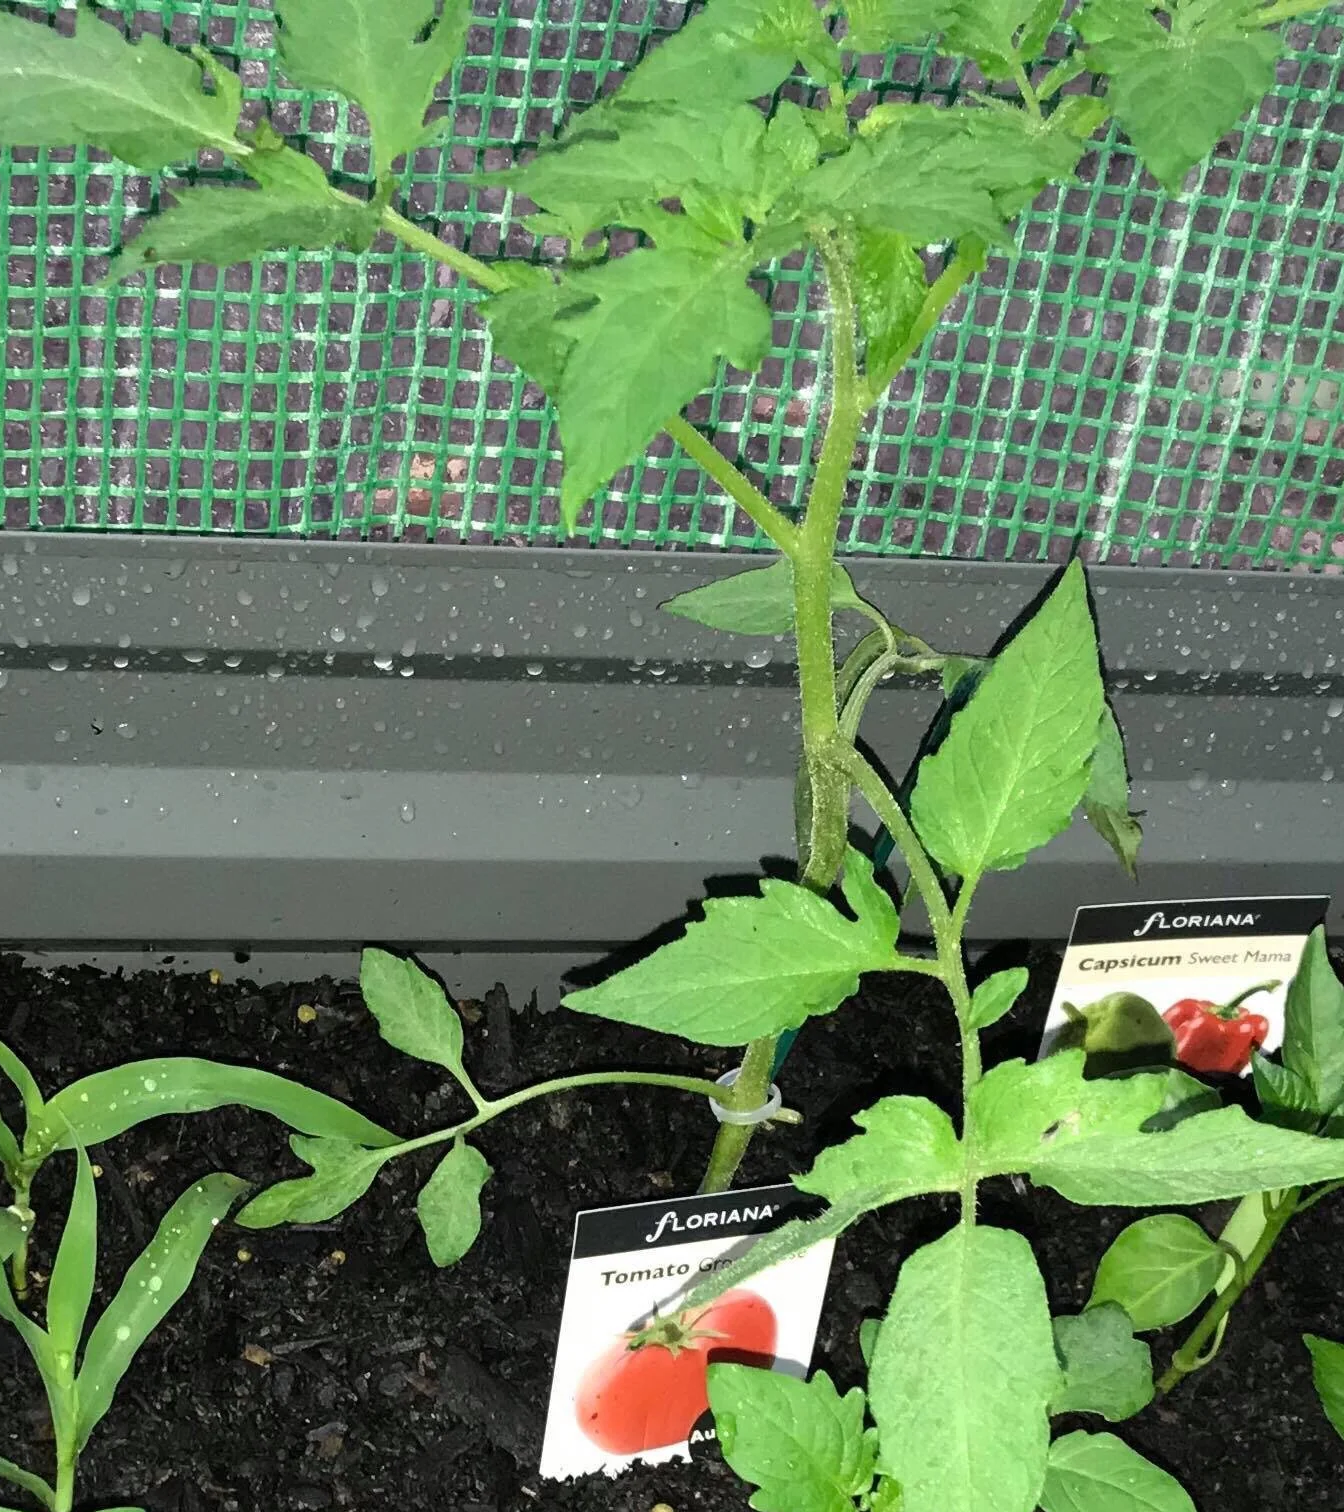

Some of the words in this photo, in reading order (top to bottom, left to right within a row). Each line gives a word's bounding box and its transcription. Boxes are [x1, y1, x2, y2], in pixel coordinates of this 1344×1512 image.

[1078, 955, 1182, 973] Capsicum
[1188, 952, 1238, 965] Sweet
[1244, 950, 1292, 964] Mama
[601, 1261, 690, 1287] Tomato
